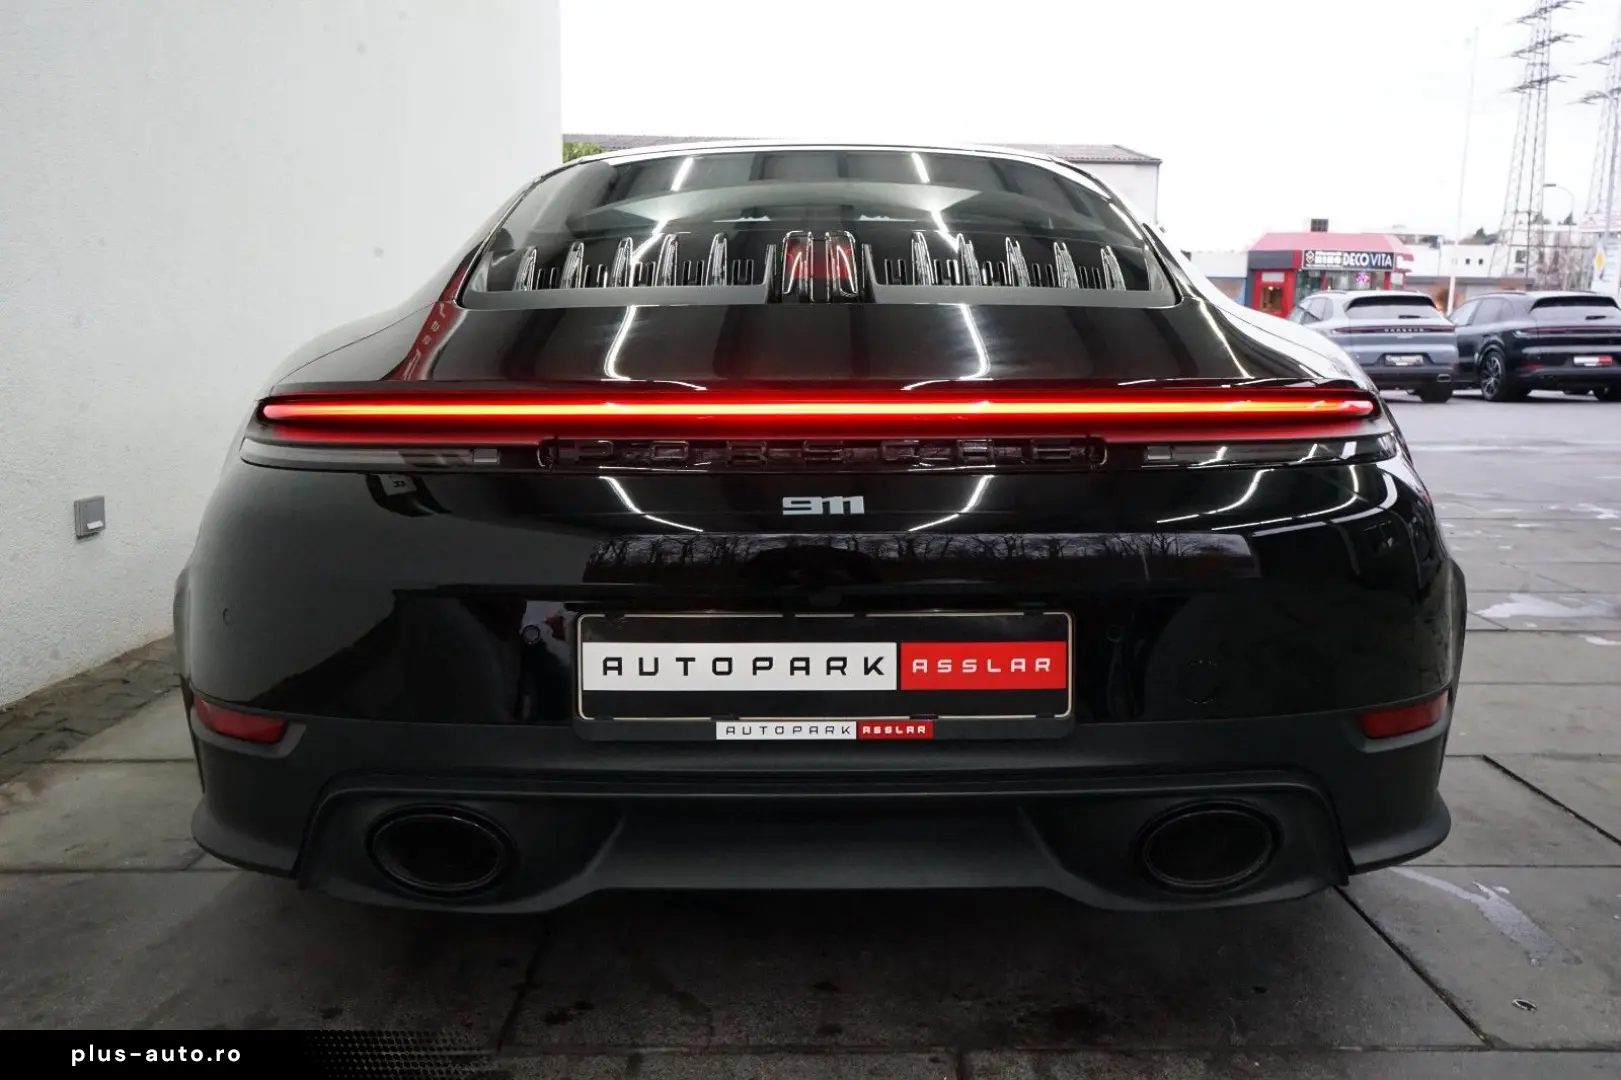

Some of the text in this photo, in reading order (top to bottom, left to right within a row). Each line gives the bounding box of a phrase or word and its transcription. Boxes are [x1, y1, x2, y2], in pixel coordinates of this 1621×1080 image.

[781, 496, 865, 515] 911
[602, 656, 1052, 677] AUTOPARK ASSLAR
[725, 725, 927, 736] AUTOPARK ASSLAR
